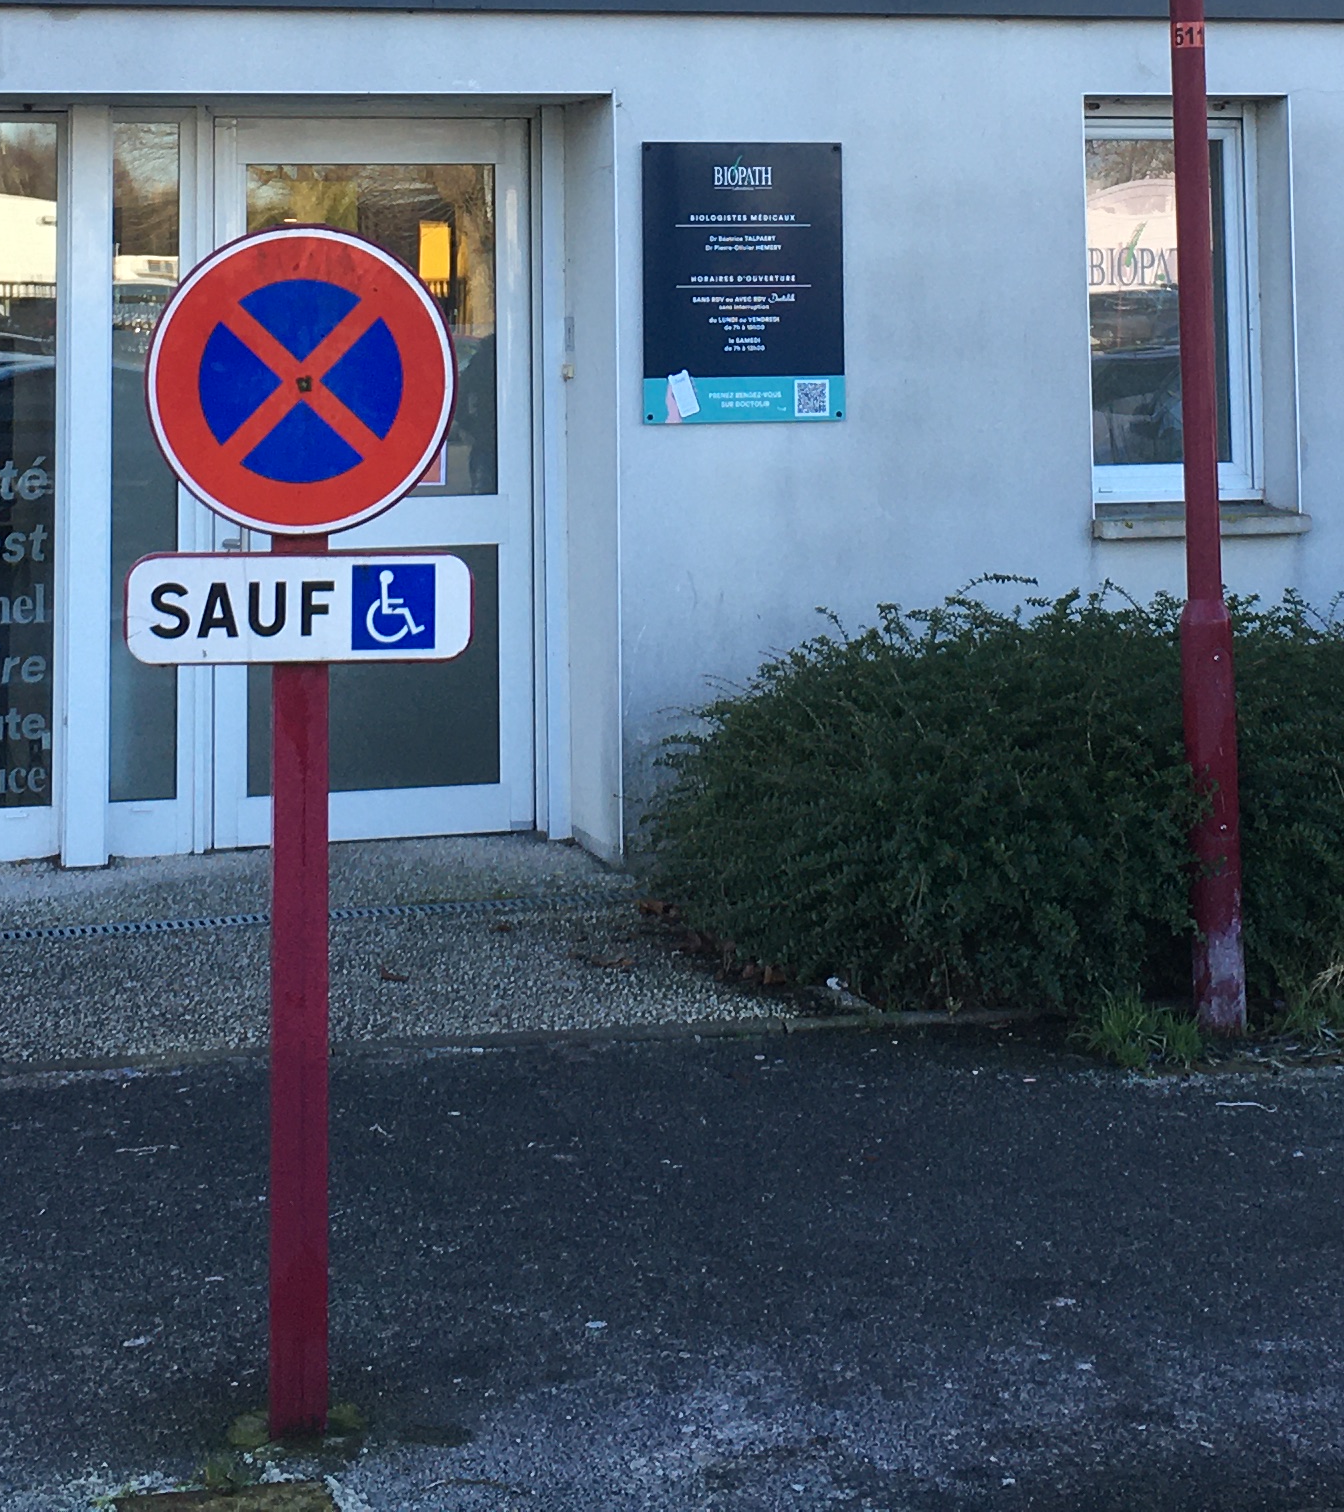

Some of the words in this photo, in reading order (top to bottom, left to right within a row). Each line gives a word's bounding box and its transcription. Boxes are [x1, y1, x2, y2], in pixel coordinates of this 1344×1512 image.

[713, 166, 773, 186] BIOPATH
[689, 214, 748, 222] BIOLOGISTES
[750, 213, 796, 222] MÉDICAUX
[1087, 247, 1178, 286] BIOPA
[690, 275, 734, 283] HORAIRES
[737, 274, 796, 283] D'OUVERTURE
[148, 580, 335, 639] SAUF
